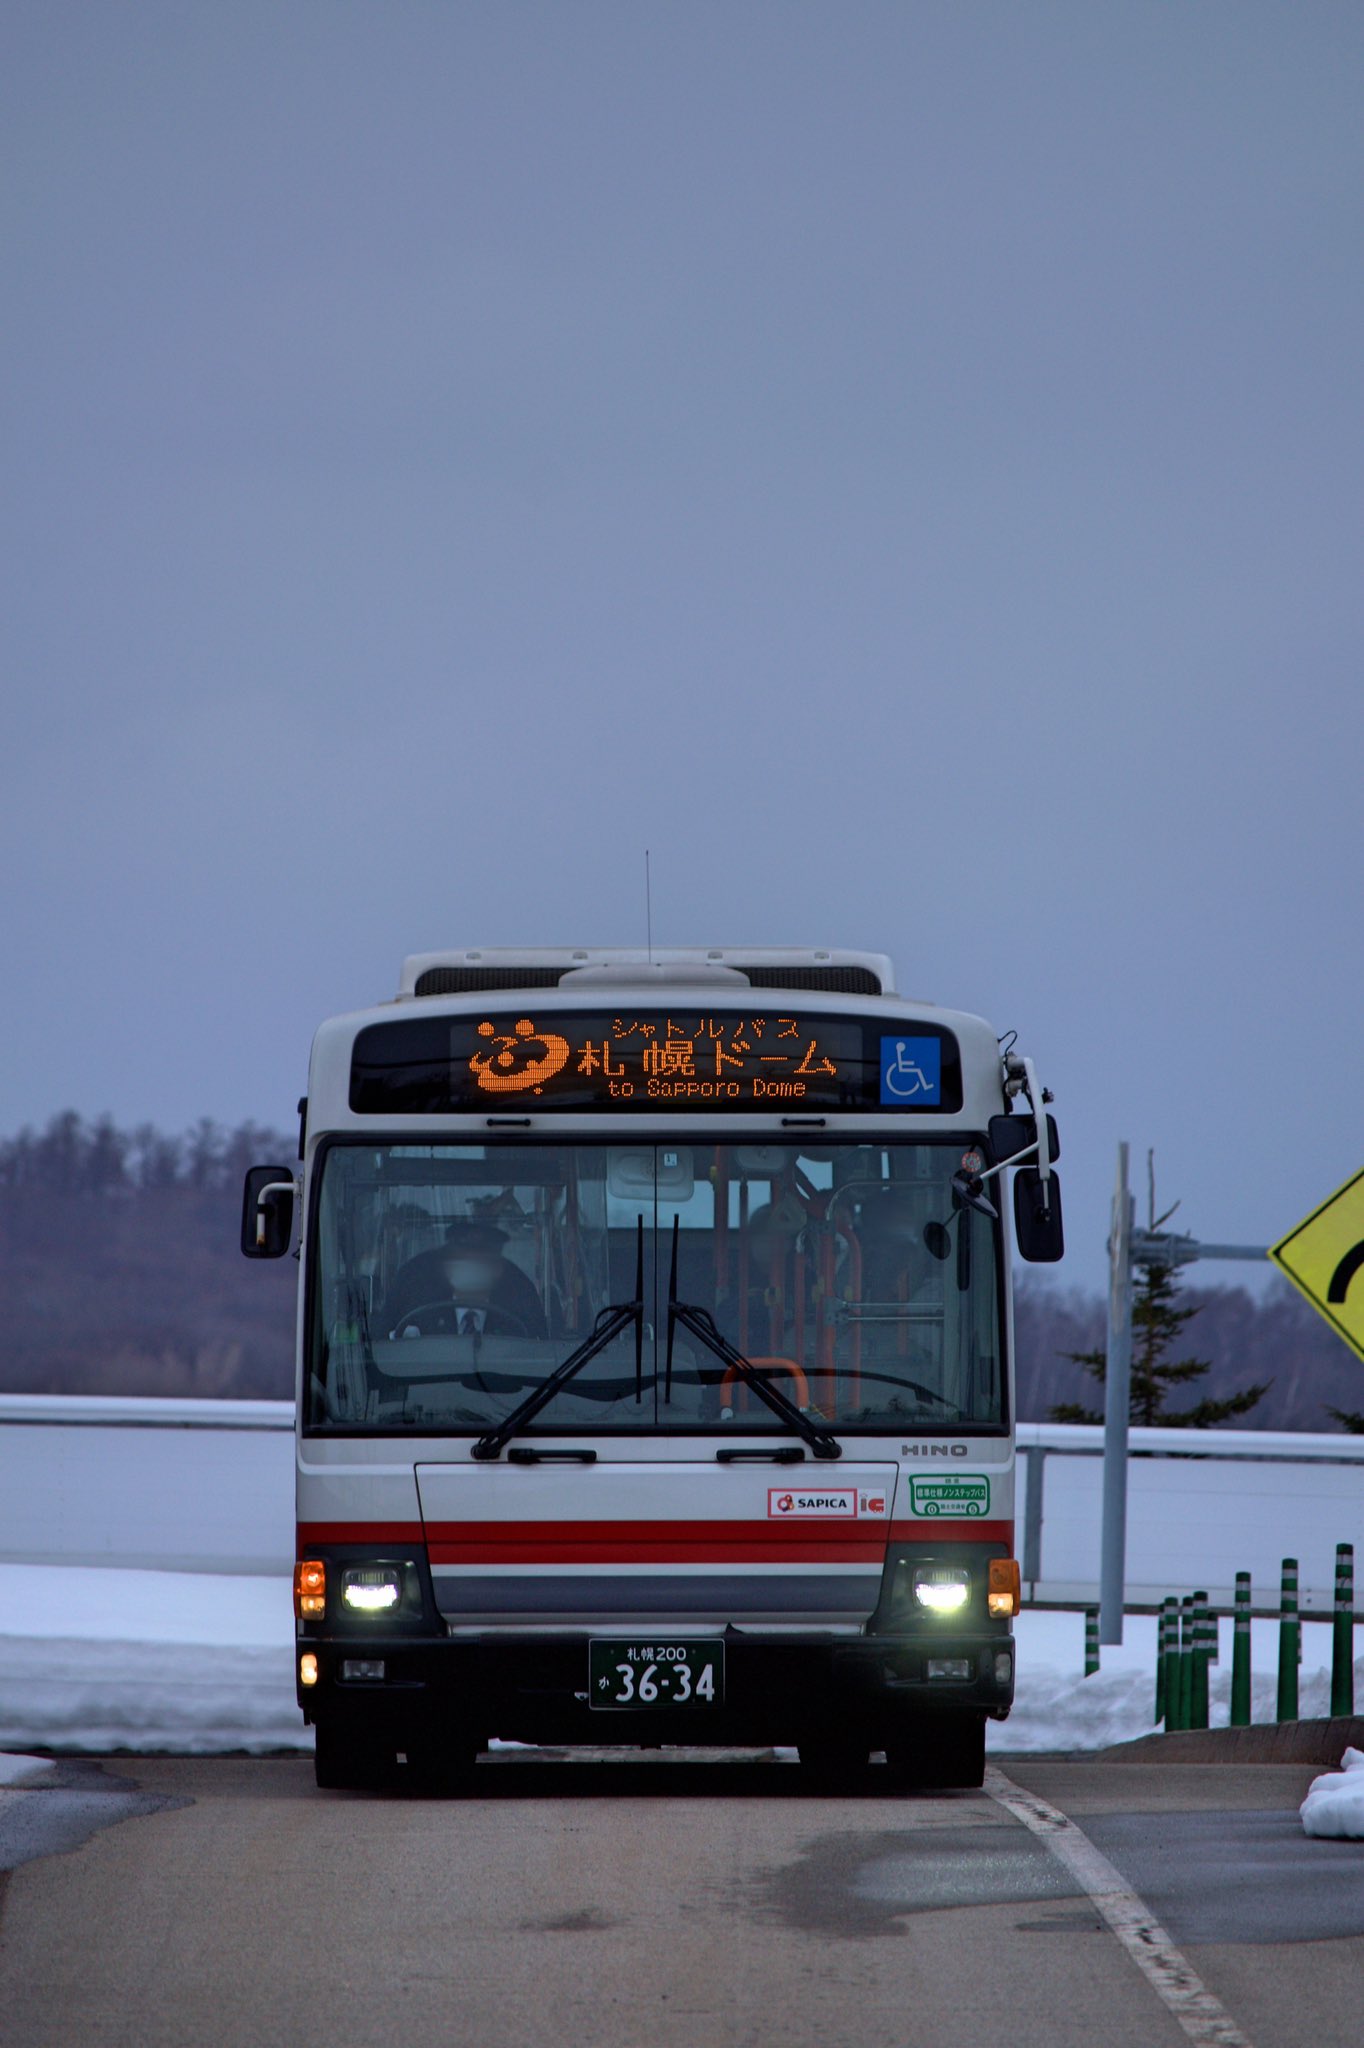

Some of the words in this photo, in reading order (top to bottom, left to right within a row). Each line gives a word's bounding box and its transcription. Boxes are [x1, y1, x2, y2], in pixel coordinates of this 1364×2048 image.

[613, 1018, 799, 1039] シャトルバス
[608, 1079, 633, 1097] to
[648, 1079, 740, 1098] Sapporo
[752, 1079, 806, 1097] Dome
[901, 1444, 968, 1457] HINO
[797, 1498, 848, 1508] SAPICA
[599, 1676, 610, 1690] か
[615, 1663, 715, 1702] 36-34
